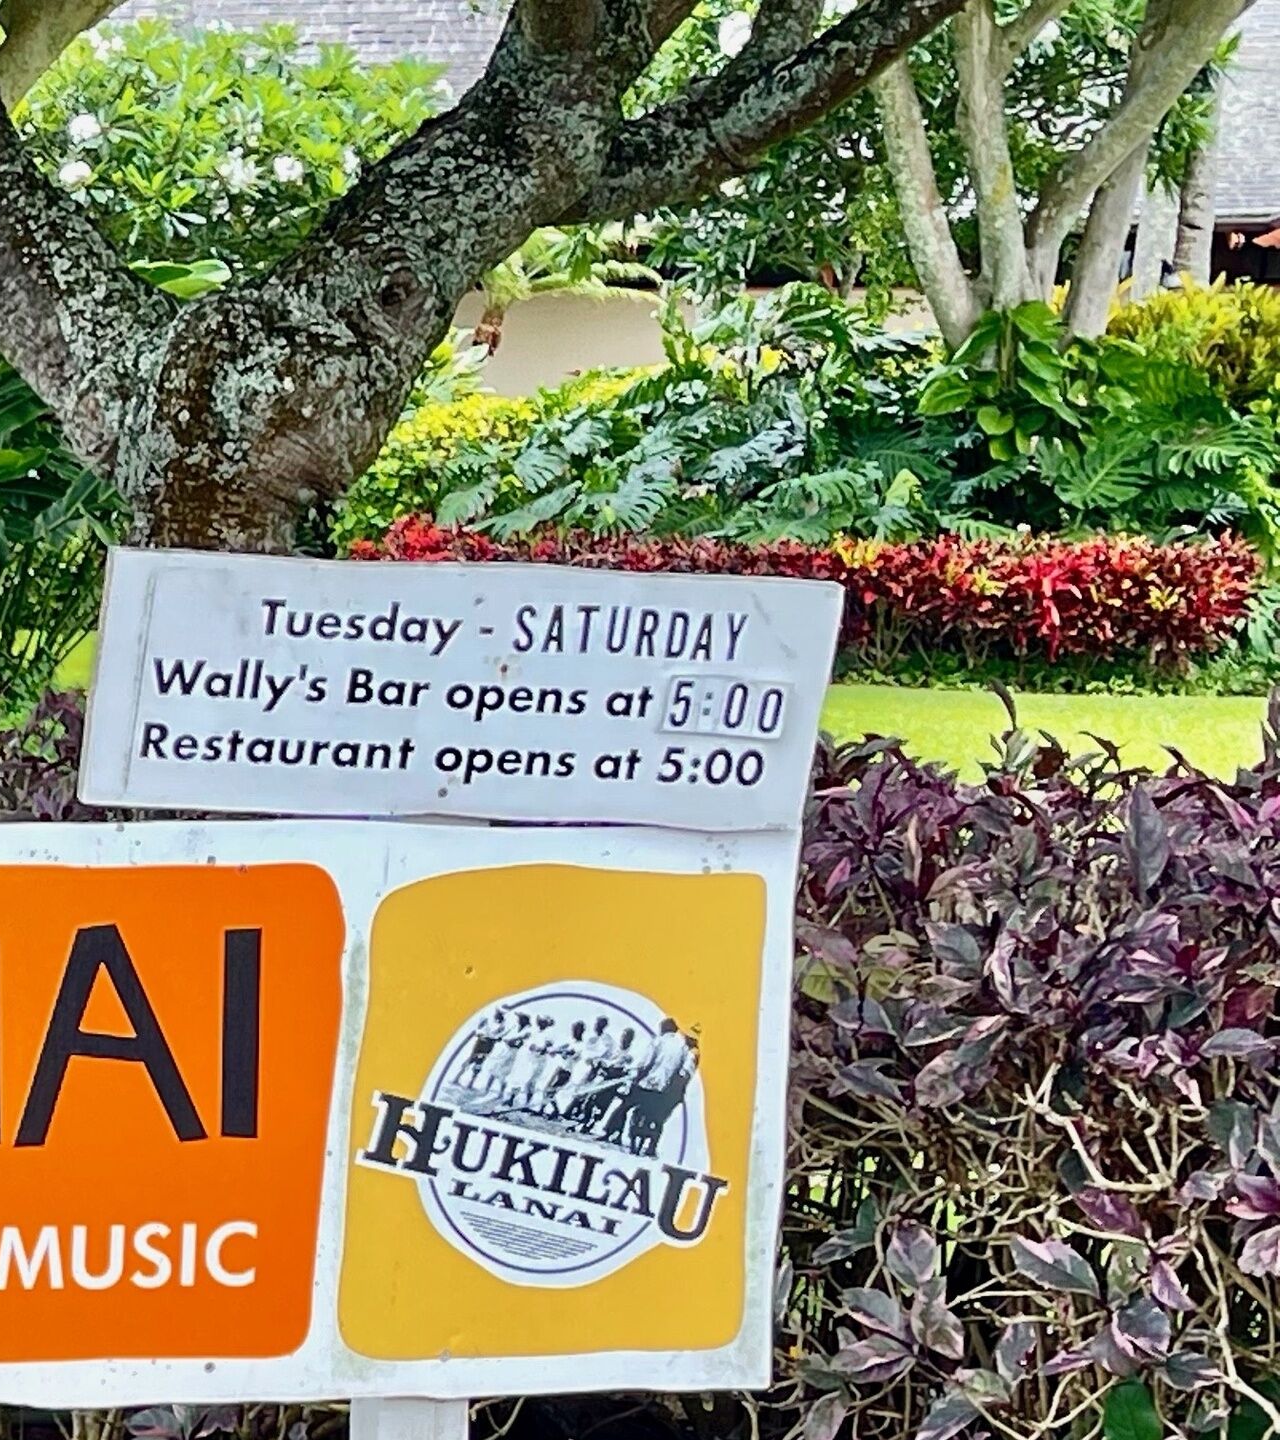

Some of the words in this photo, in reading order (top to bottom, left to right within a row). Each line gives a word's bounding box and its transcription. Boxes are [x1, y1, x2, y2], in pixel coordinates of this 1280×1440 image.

[261, 598, 463, 657] Tuesday
[512, 605, 750, 662] SATURDAY
[153, 657, 328, 713] Wally's
[346, 667, 431, 708] Bar
[446, 683, 588, 722] opens
[606, 686, 654, 718] at
[668, 680, 785, 734] 5:00
[140, 722, 415, 770] Restaurant
[434, 746, 577, 785] opens
[594, 749, 642, 780] at
[657, 747, 764, 786] 5:00
[364, 1092, 729, 1242] HUKILAU
[447, 1179, 623, 1238] LANAI
